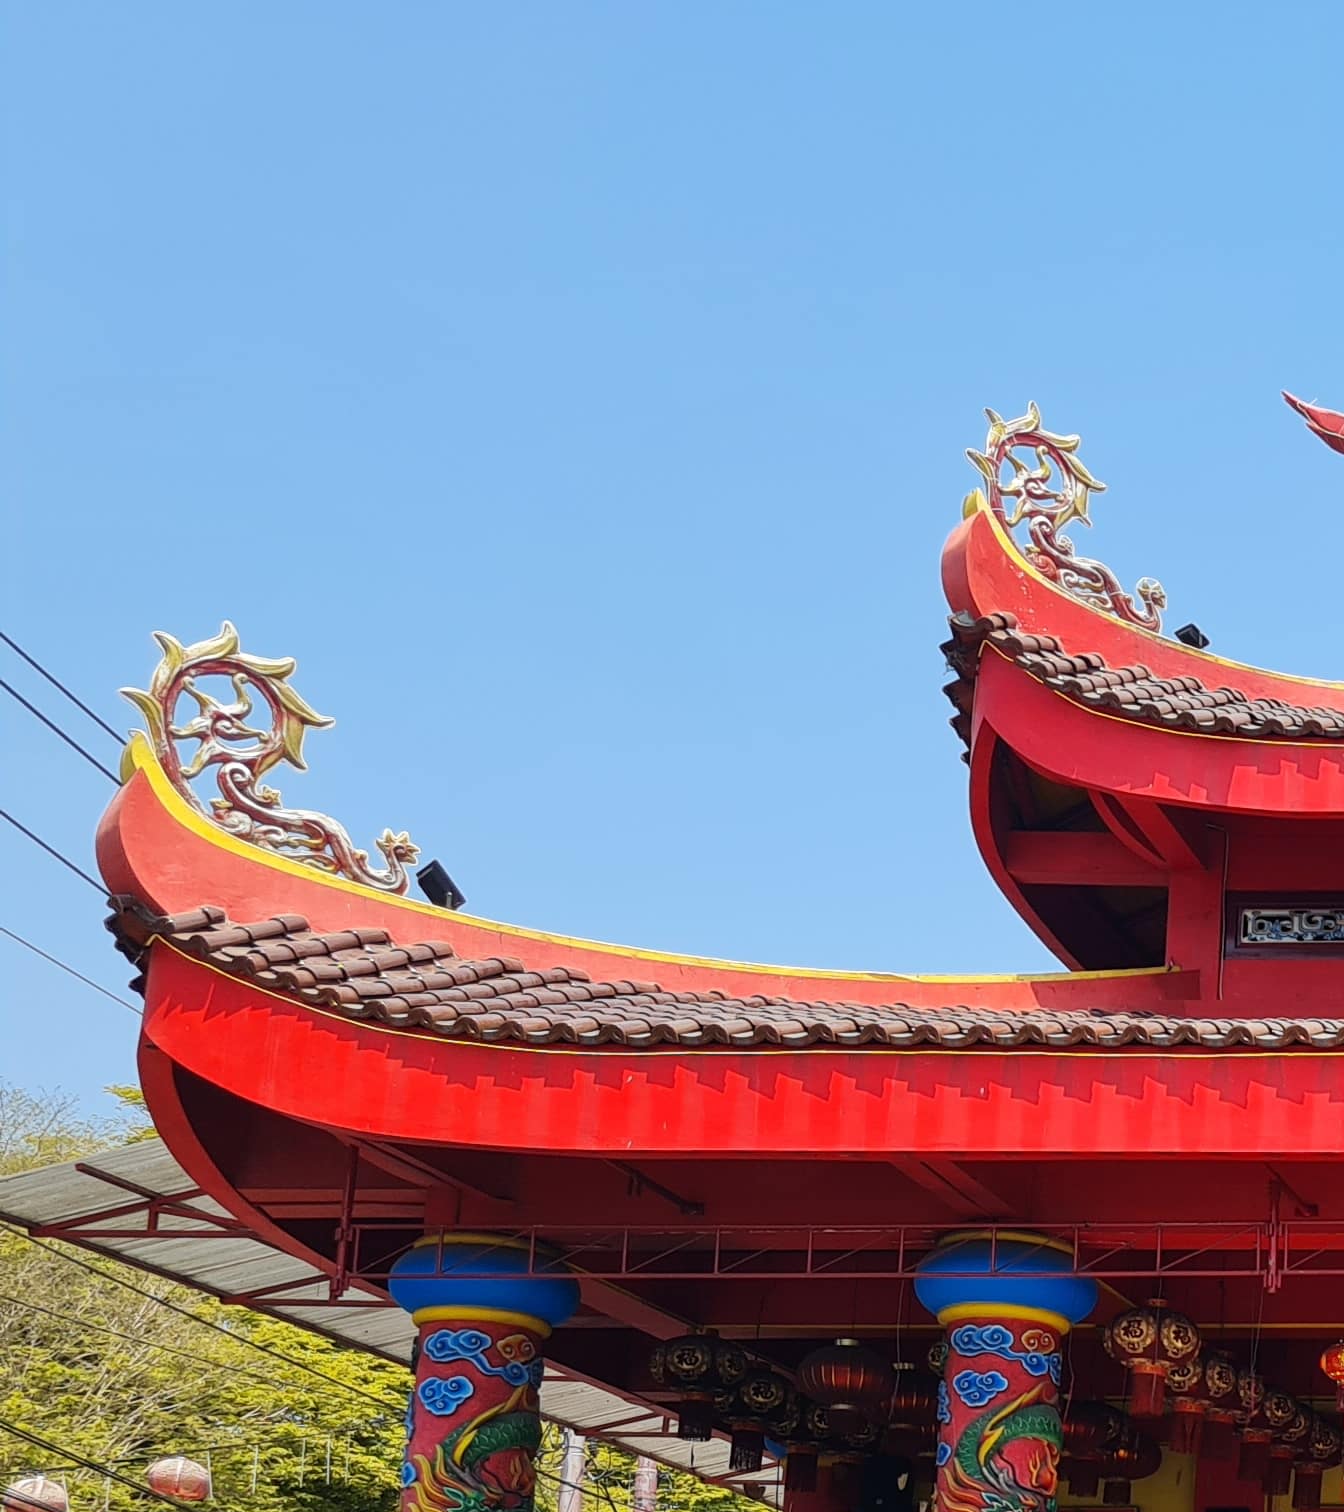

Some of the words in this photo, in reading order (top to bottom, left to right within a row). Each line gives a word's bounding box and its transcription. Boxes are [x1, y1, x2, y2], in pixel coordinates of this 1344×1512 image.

[1121, 1319, 1144, 1338] 福
[675, 1347, 699, 1366] 福
[752, 1381, 776, 1402] 福
